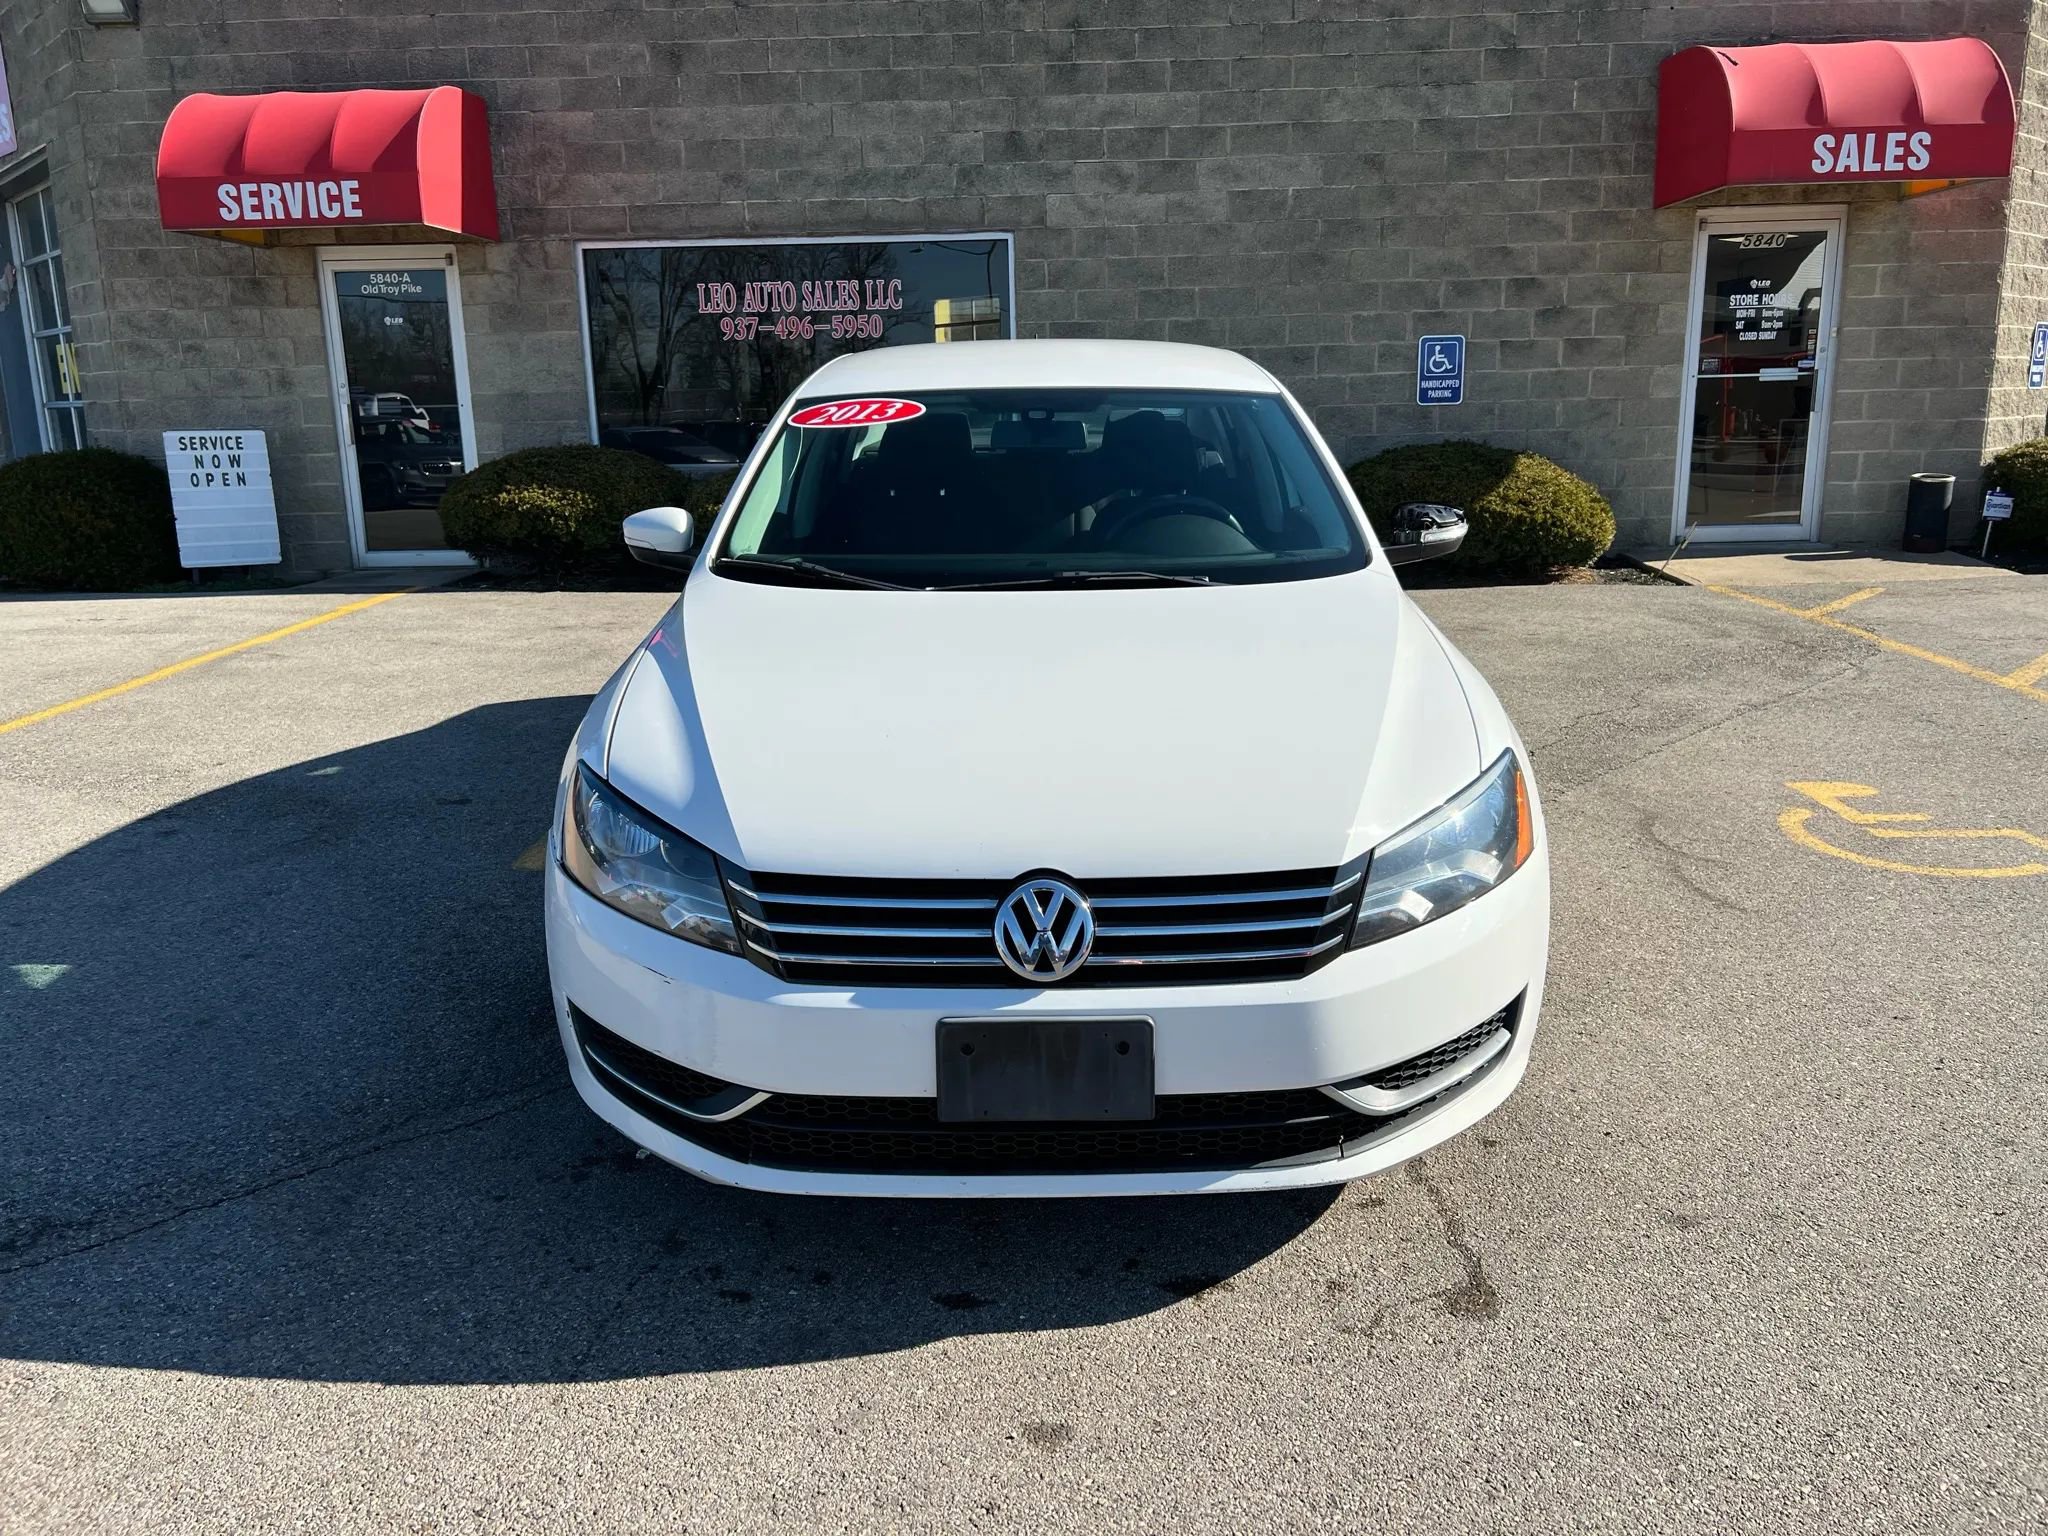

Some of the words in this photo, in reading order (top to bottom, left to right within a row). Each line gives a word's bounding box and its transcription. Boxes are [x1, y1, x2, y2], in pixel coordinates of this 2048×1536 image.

[1811, 131, 1932, 174] SALES
[217, 180, 363, 222] SERVICE
[1742, 233, 1785, 248] 5840
[369, 273, 411, 284] 5840-A
[361, 285, 379, 294] Old
[379, 285, 399, 296] Troy
[401, 284, 422, 293] Pike
[697, 283, 737, 314] LEO
[742, 281, 797, 313] AUTO
[802, 280, 860, 312] SALES
[865, 279, 903, 311] LLC
[1729, 294, 1759, 306] STORE
[720, 314, 884, 341] 937-496-5950
[1735, 320, 1745, 330] SAT
[1739, 332, 1758, 341] CLOSED
[1758, 331, 1777, 340] SUNDAY
[1421, 379, 1460, 388] HANDICAPPED
[1427, 389, 1452, 398] PARKING
[805, 402, 904, 425] 2013
[178, 436, 244, 451] SERVICE
[194, 453, 241, 469] NOW
[190, 471, 247, 487] OPEN
[994, 879, 1094, 982] VW
